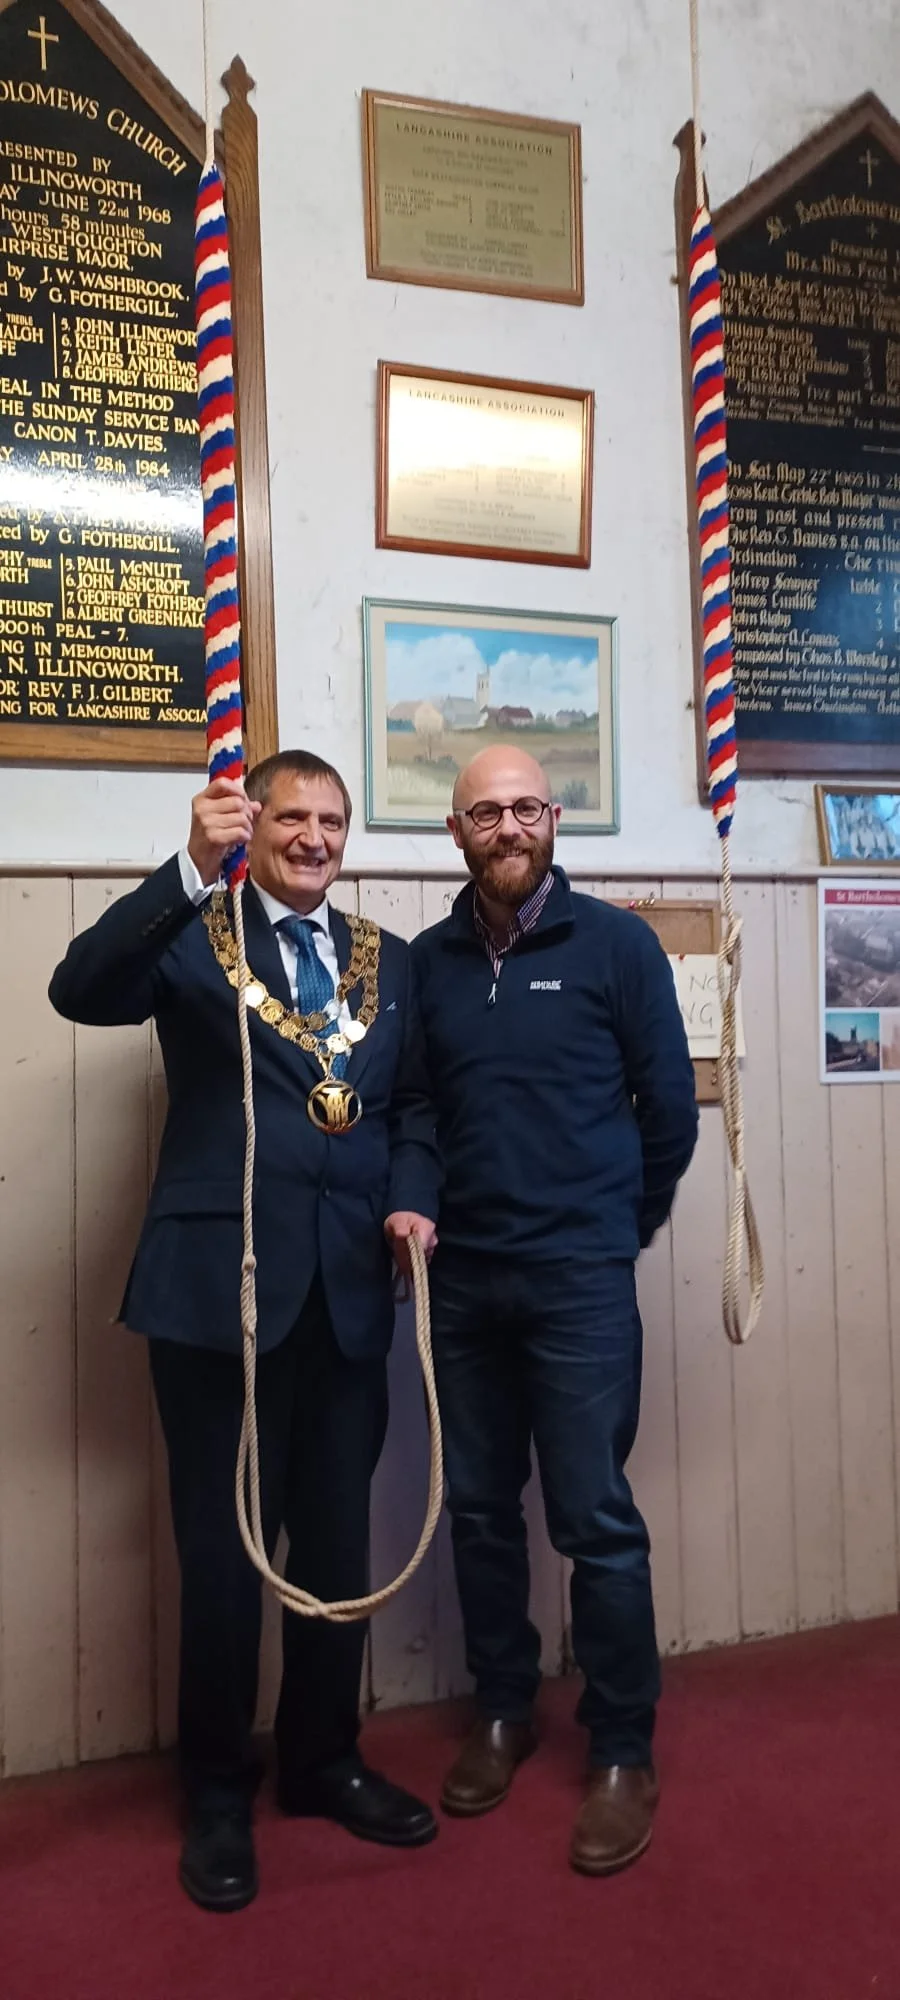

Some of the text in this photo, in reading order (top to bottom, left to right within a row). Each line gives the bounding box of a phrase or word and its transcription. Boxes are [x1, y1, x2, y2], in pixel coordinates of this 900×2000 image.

[107, 108, 187, 177] CHURCH
[395, 121, 553, 156] LANCASHIRE ASSOCIATION
[92, 157, 111, 174] BY
[11, 164, 142, 200] ILLINGWORTH
[39, 191, 89, 212] JUNE
[98, 199, 129, 218] 22nd
[138, 205, 171, 224] 1968
[1, 204, 145, 241] hours 58 minutes
[12, 222, 162, 260] WESTHOUGHTON
[7, 261, 25, 281] by
[40, 266, 52, 284] J.
[56, 268, 75, 285] W.
[19, 283, 37, 302] by
[49, 287, 67, 304] G.
[6, 313, 33, 326] TREBLE
[75, 316, 114, 338] JOHN
[75, 331, 120, 352] KEITH
[127, 340, 176, 359] LISTER
[75, 365, 140, 386] GEOFFREY
[77, 349, 124, 368] JAMES
[128, 355, 197, 377] ANDREWS
[0, 377, 174, 412] EAL IN THE METHOD
[409, 388, 565, 419] LANCASHIRE ASSOCIATION
[0, 399, 25, 417] HE
[32, 402, 97, 424] SUNDAY
[104, 410, 170, 432] SERVICE
[14, 421, 77, 443] CANON
[85, 428, 100, 446] T.
[37, 450, 87, 470] APRIL
[95, 455, 127, 475] 28th
[135, 459, 171, 478] 1984
[730, 506, 758, 524] rom
[804, 510, 832, 528] and
[30, 525, 49, 545] by
[58, 528, 75, 545] G.
[27, 557, 52, 570] TREBLE
[77, 556, 114, 575] PAUL
[120, 559, 182, 580] McNUTT
[0, 567, 29, 585] RTH
[77, 572, 114, 591] JOHN
[120, 578, 190, 596] ASHCROFT
[77, 588, 142, 609] GEOFFREY
[77, 605, 124, 623] ALBERT
[56, 623, 95, 640] PEAL
[34, 641, 52, 656] IN
[61, 643, 154, 662] MEMORIUM
[38, 658, 184, 683] ILLINGWORTH.
[28, 681, 65, 698] REV.
[72, 684, 84, 699] F.
[88, 684, 99, 702] J.
[29, 701, 58, 717] FOR
[67, 703, 151, 720] LANCASHIRE
